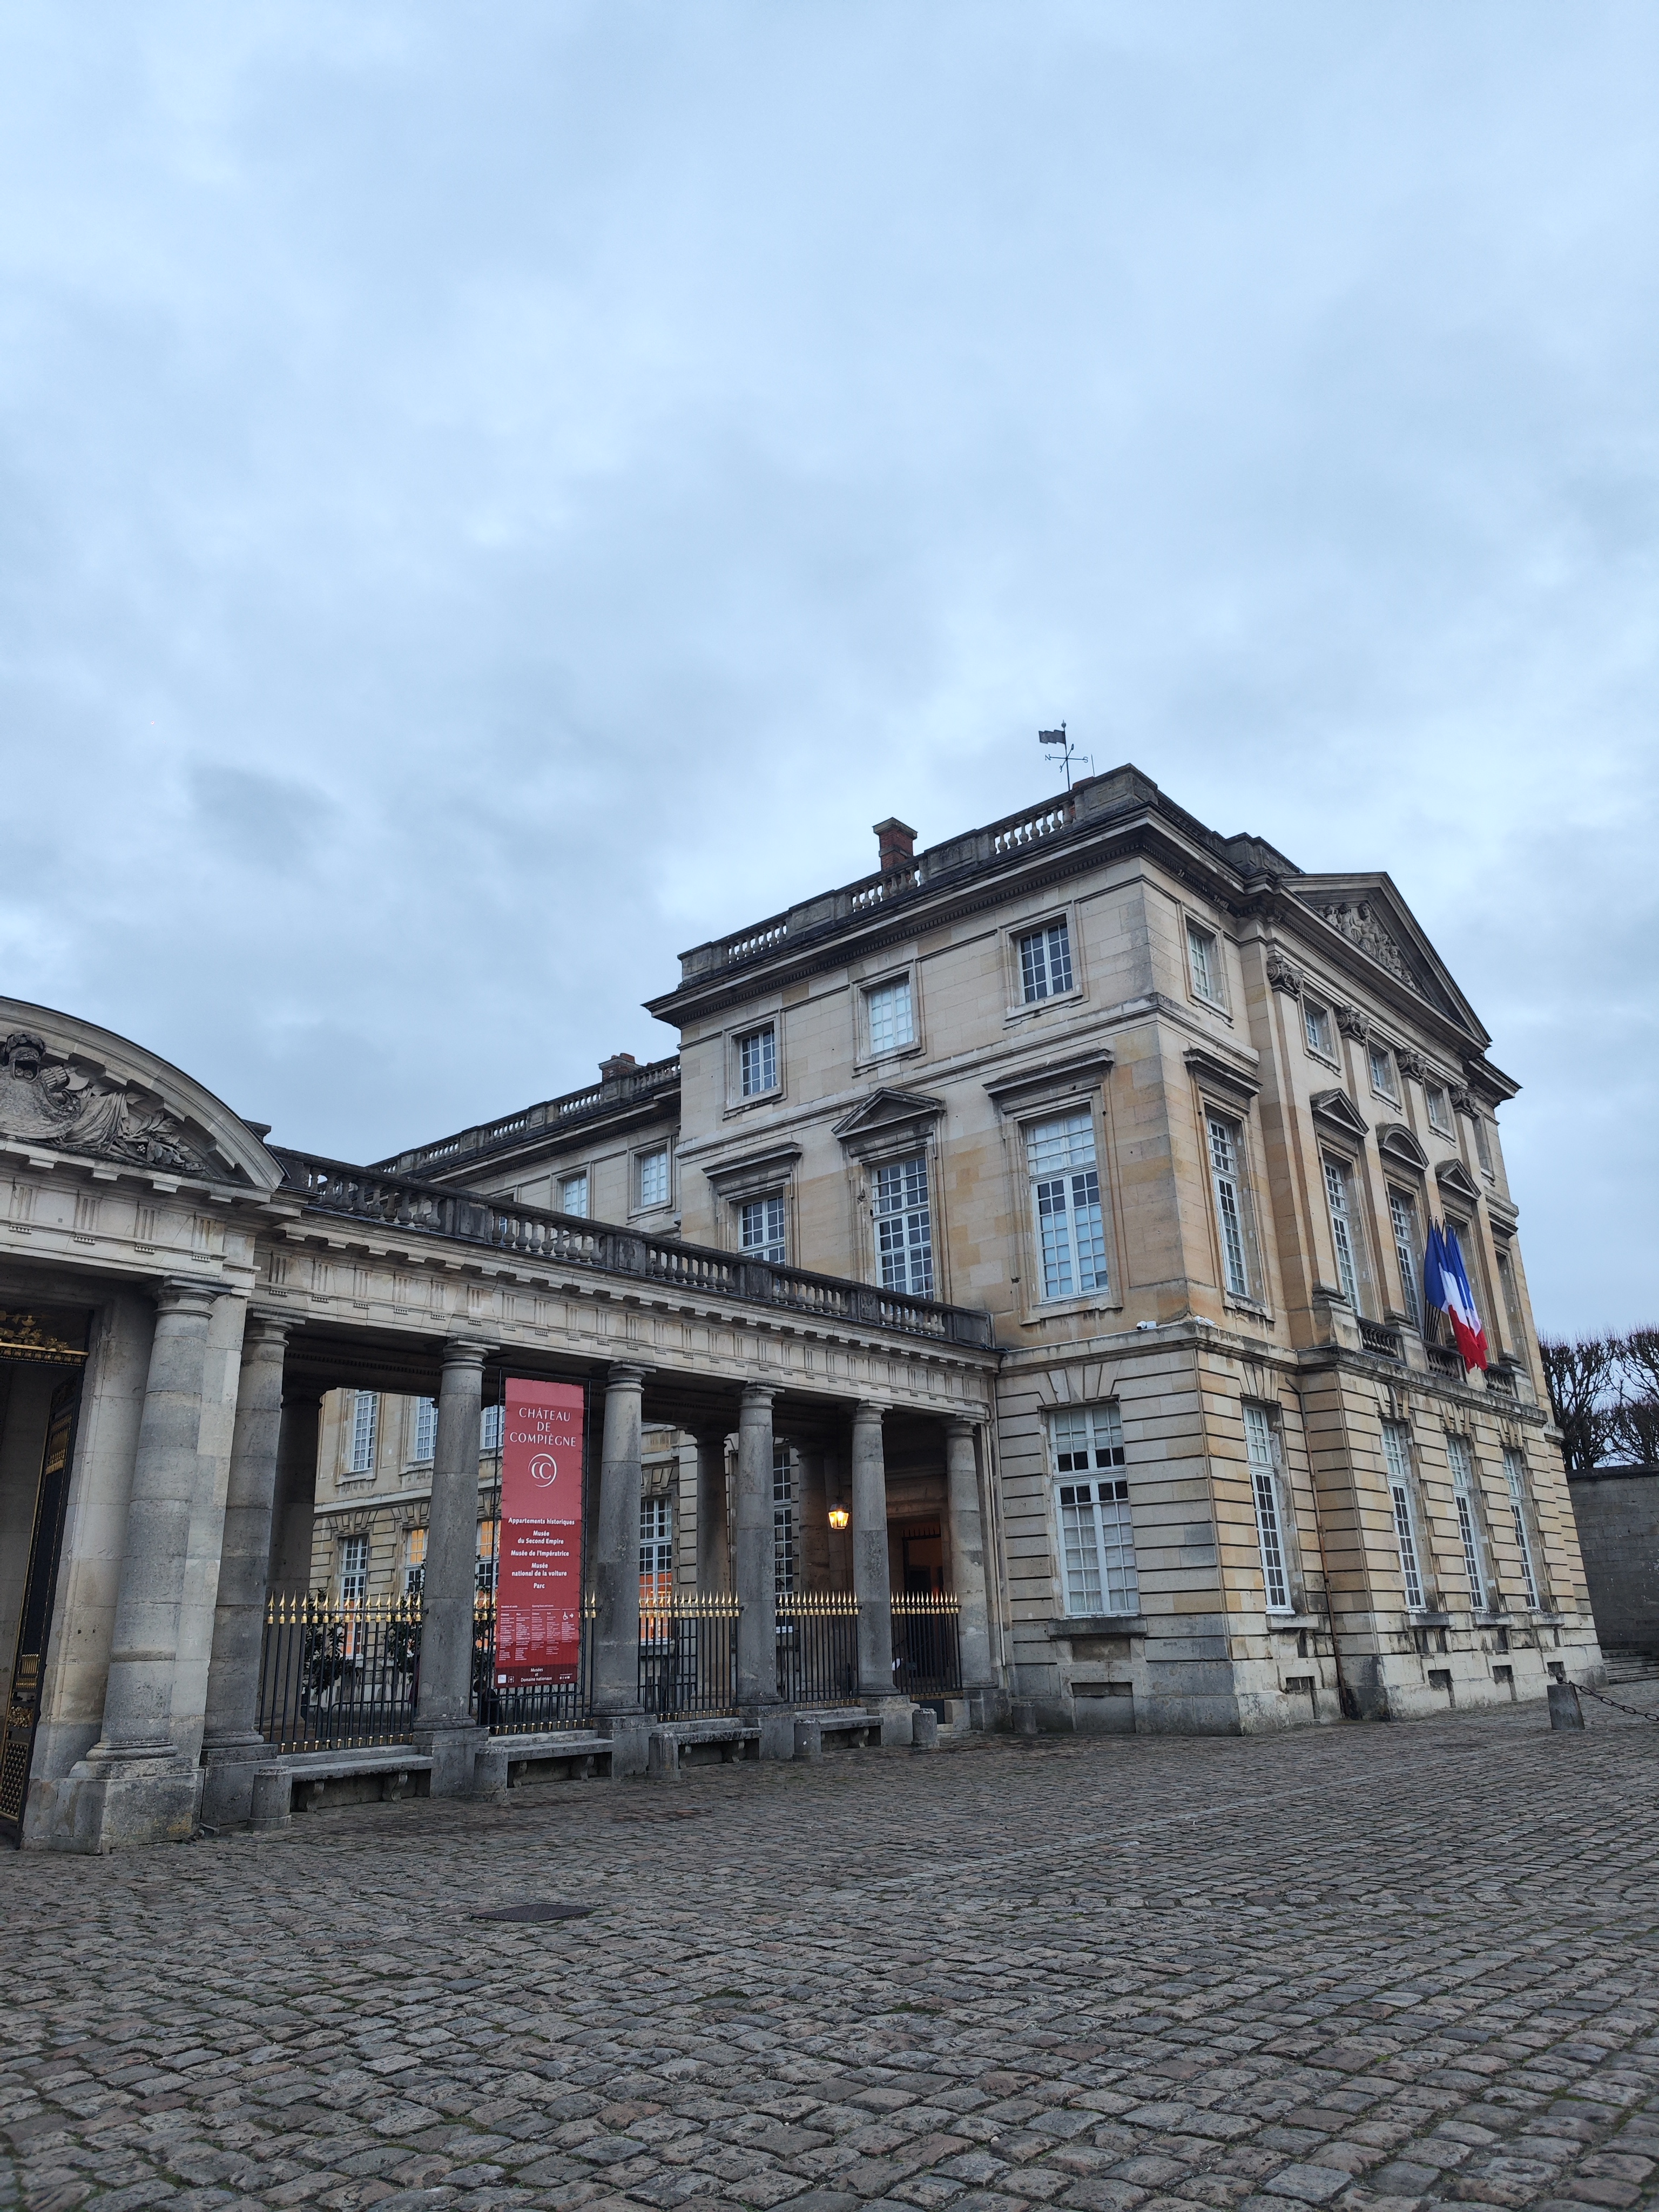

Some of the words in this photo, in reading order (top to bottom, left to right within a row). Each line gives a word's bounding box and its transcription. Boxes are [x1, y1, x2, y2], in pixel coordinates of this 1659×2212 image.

[519, 1407, 570, 1422] CHÂTEAU
[537, 1421, 551, 1432] DE
[510, 1432, 576, 1447] COMPIÈGNE
[508, 1517, 545, 1525] Appartements
[546, 1518, 575, 1526] historiques
